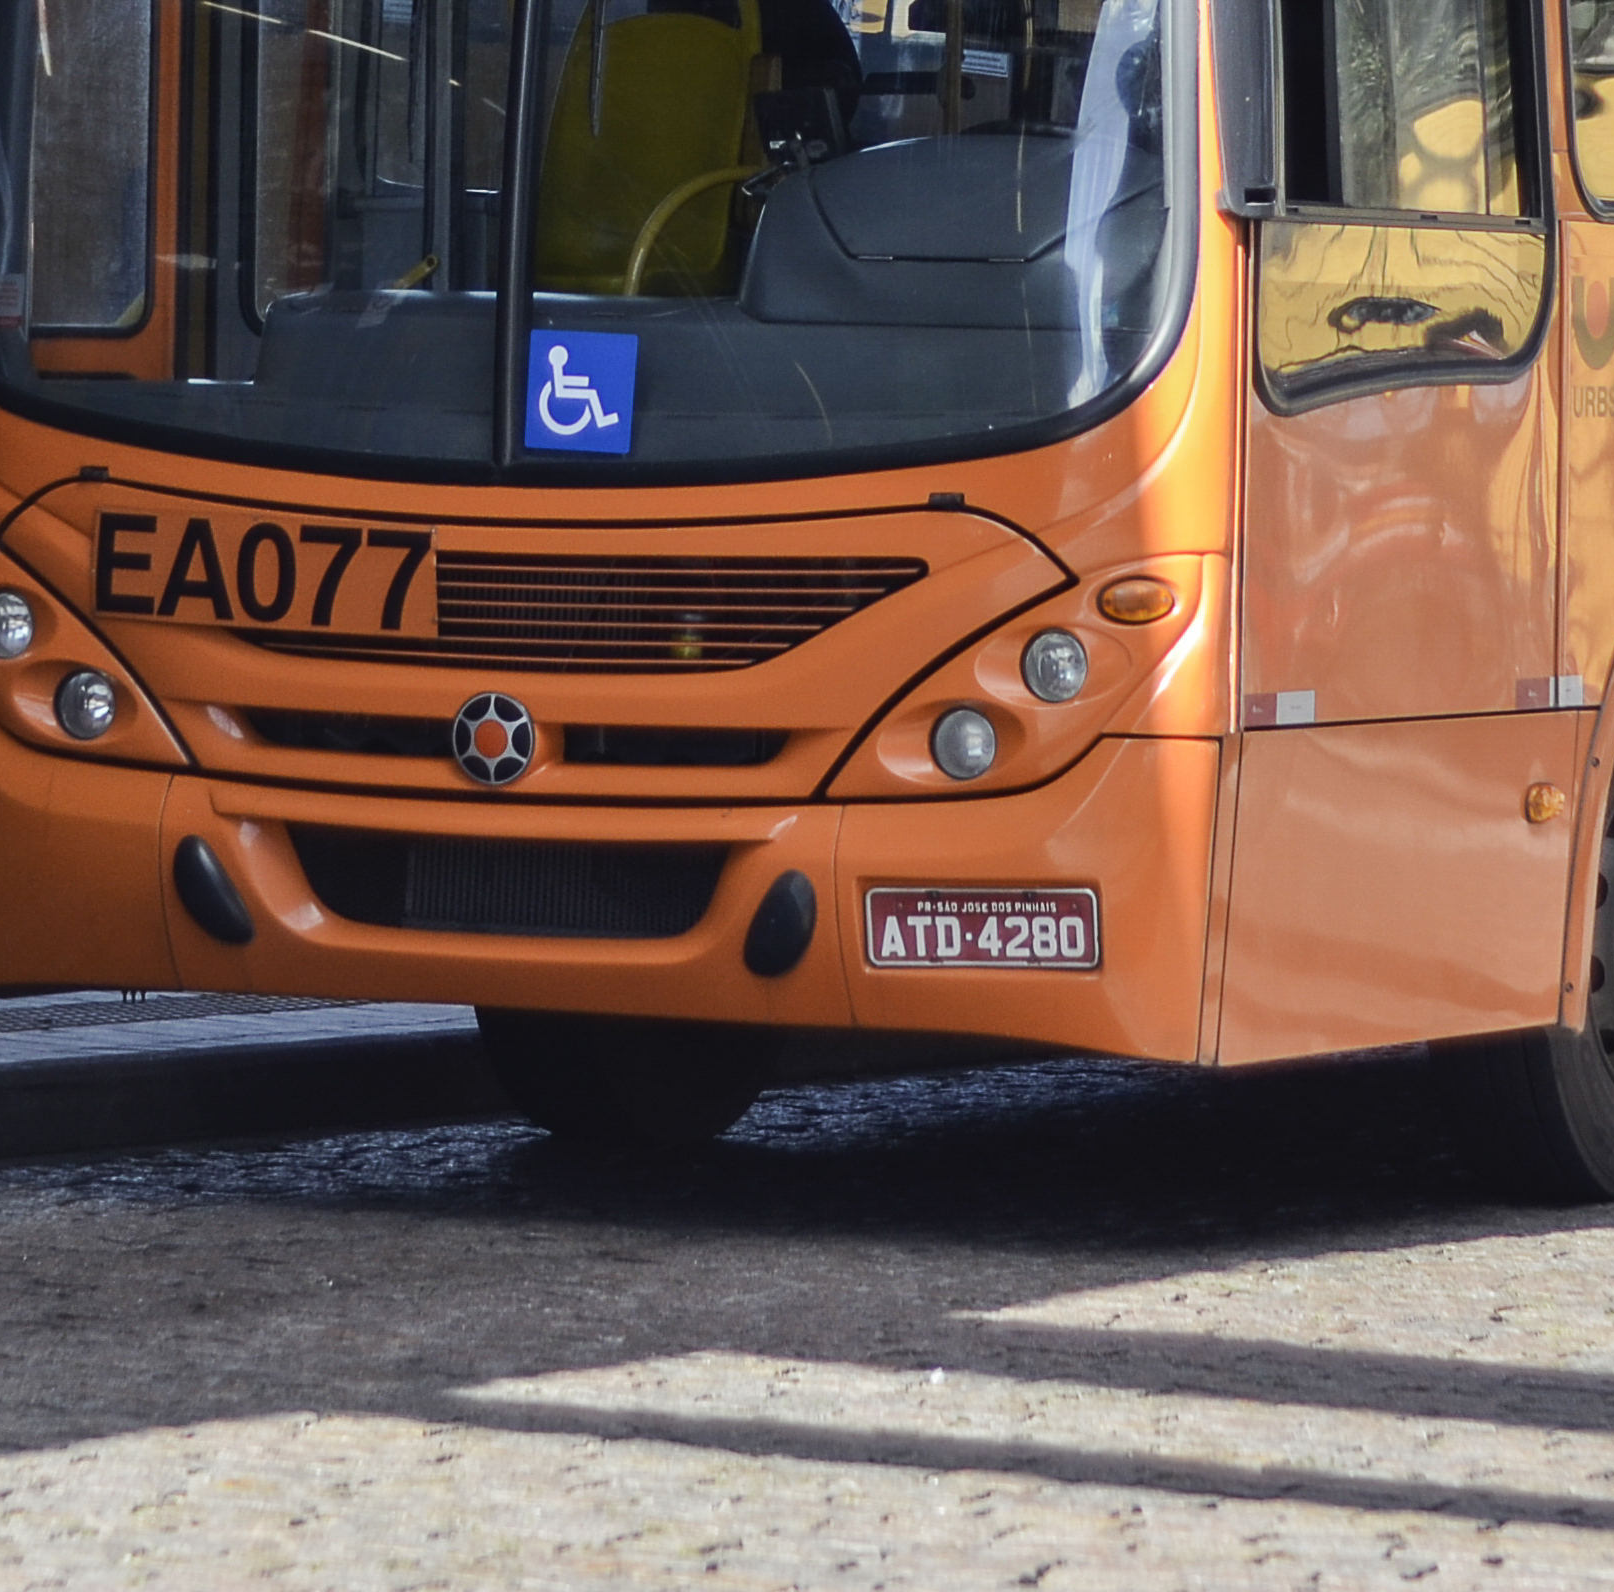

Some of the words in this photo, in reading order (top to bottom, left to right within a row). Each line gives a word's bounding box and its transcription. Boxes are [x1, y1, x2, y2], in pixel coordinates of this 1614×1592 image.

[95, 511, 432, 631] EA077
[991, 902, 1012, 913] DOS
[1015, 902, 1057, 914] PINHAIS
